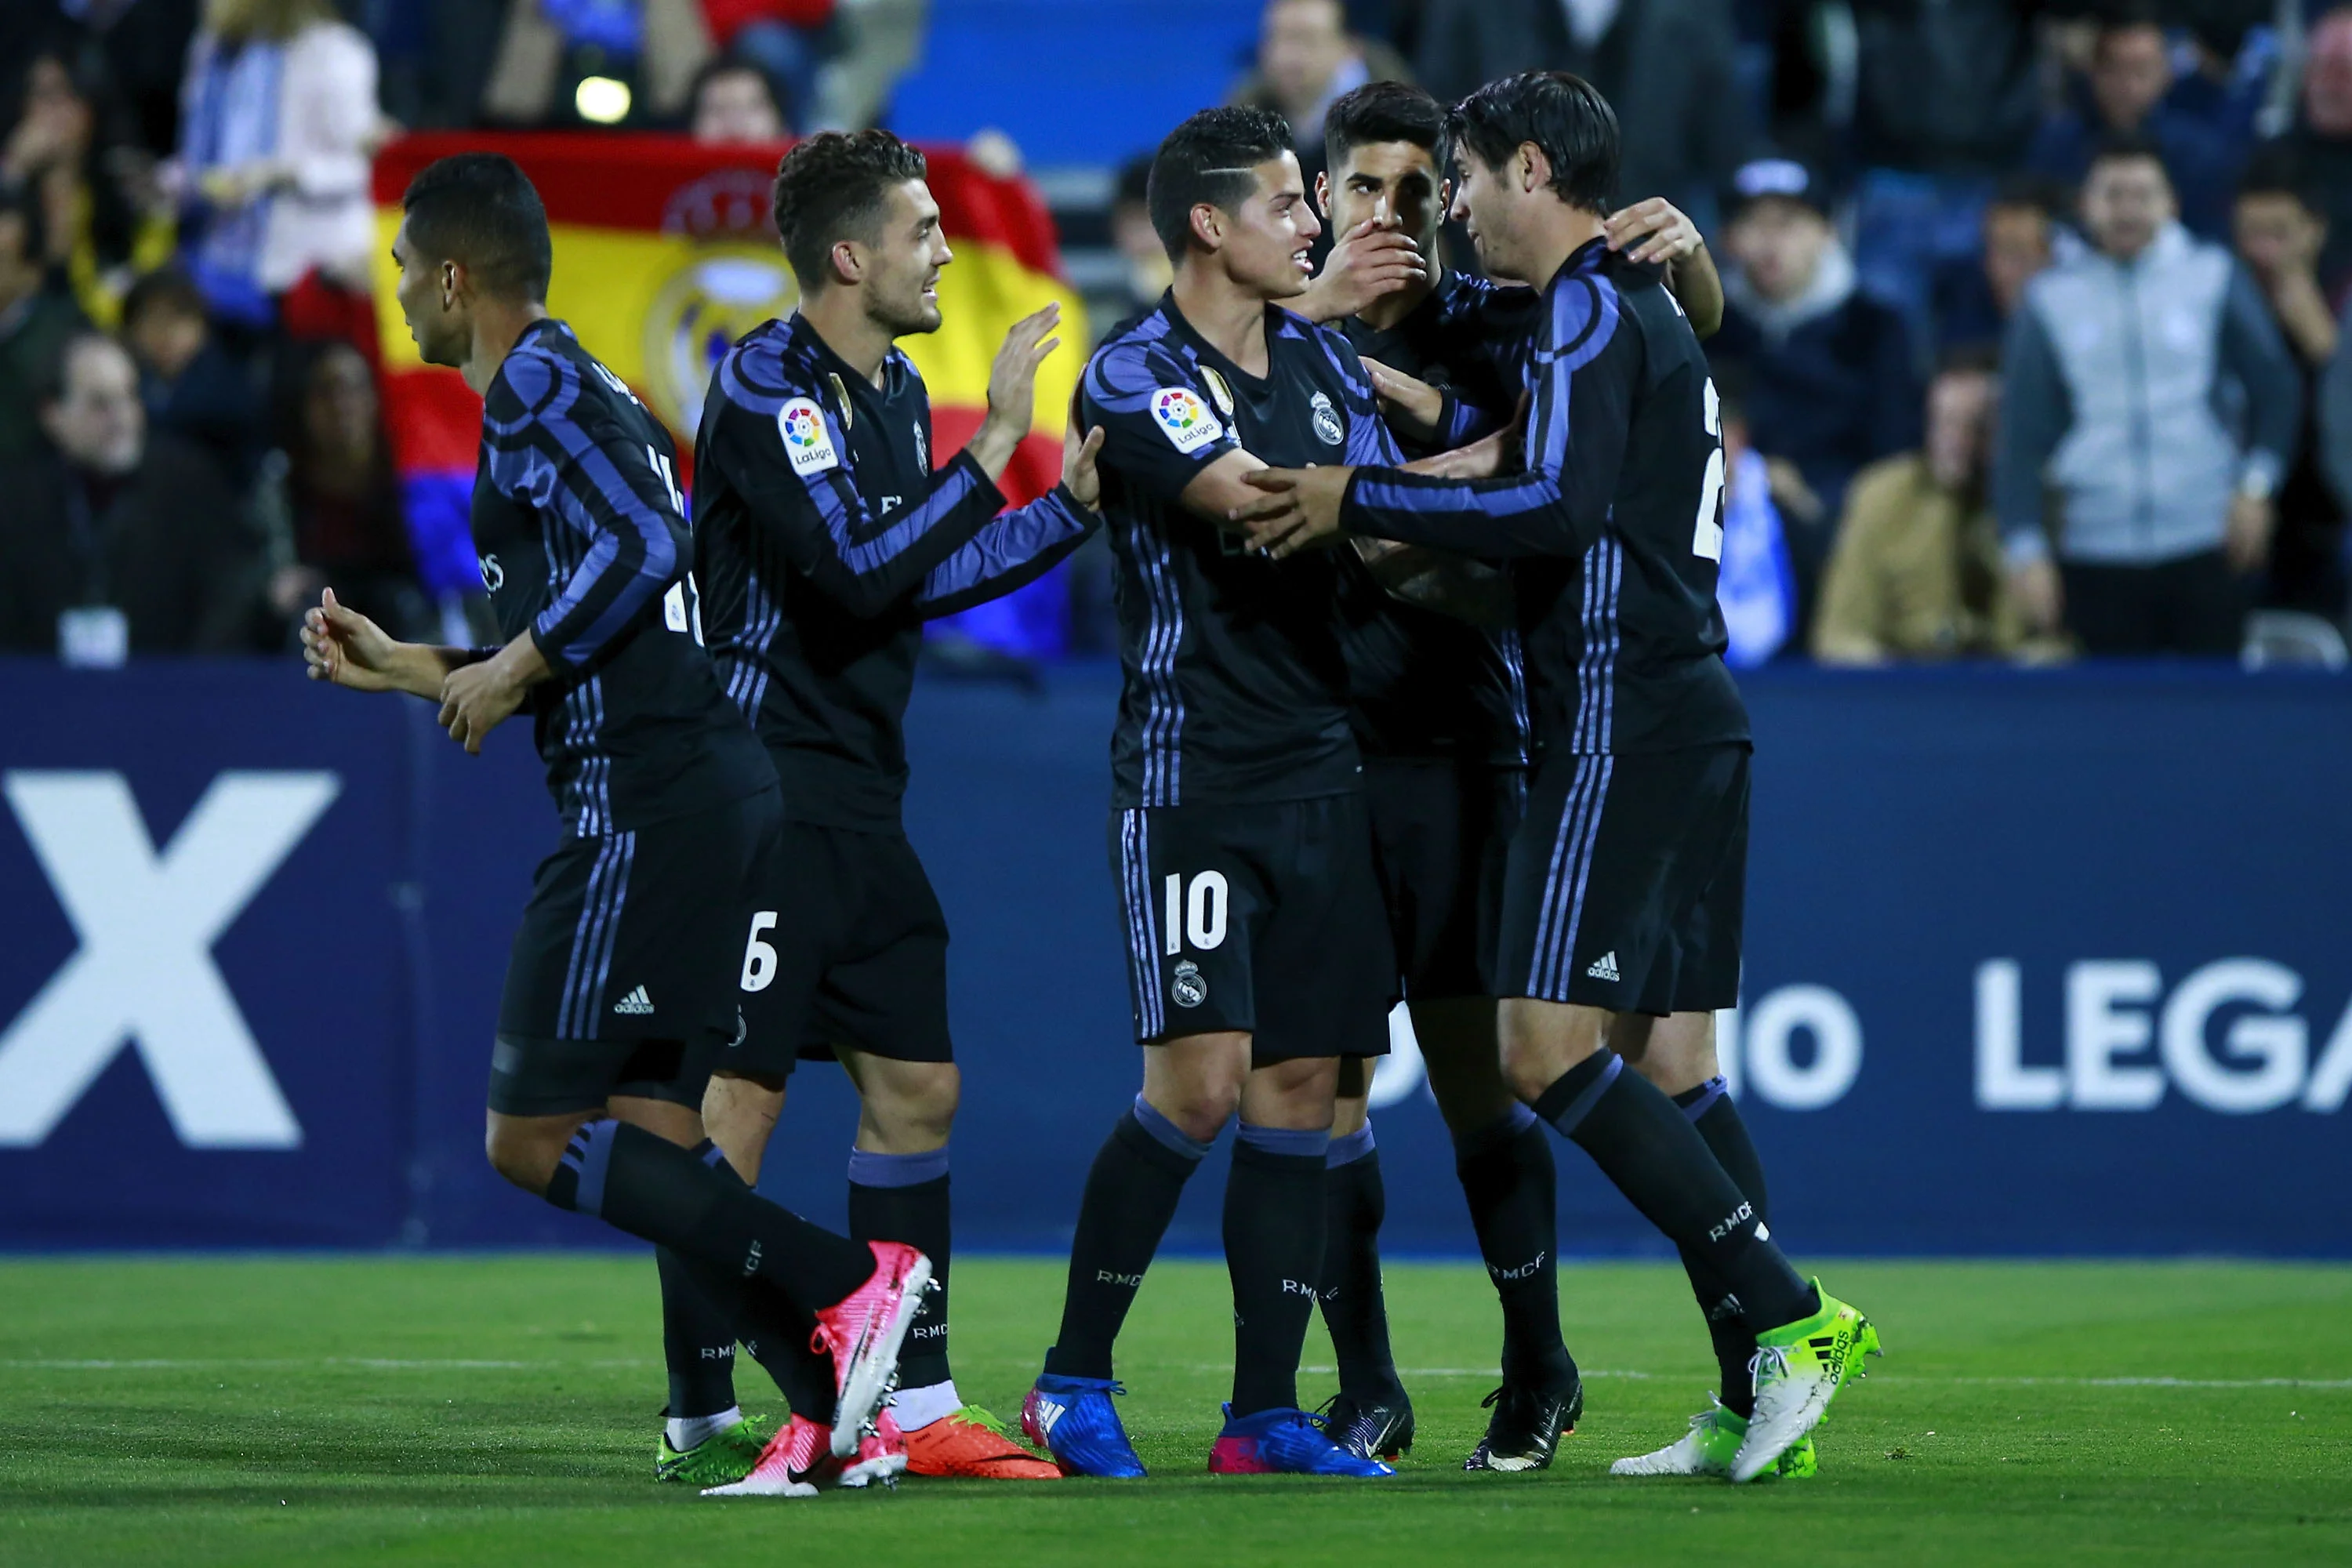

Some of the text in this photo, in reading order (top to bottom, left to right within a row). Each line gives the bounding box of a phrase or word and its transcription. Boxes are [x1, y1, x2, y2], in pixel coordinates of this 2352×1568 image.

[796, 448, 831, 465] LaLiga
[1178, 423, 1214, 444] LaLiga
[1166, 869, 1229, 956] 10
[0, 768, 343, 1150] X
[740, 910, 778, 993] 6
[1587, 966, 1621, 982] adidas
[1830, 1330, 1849, 1385] adidas
